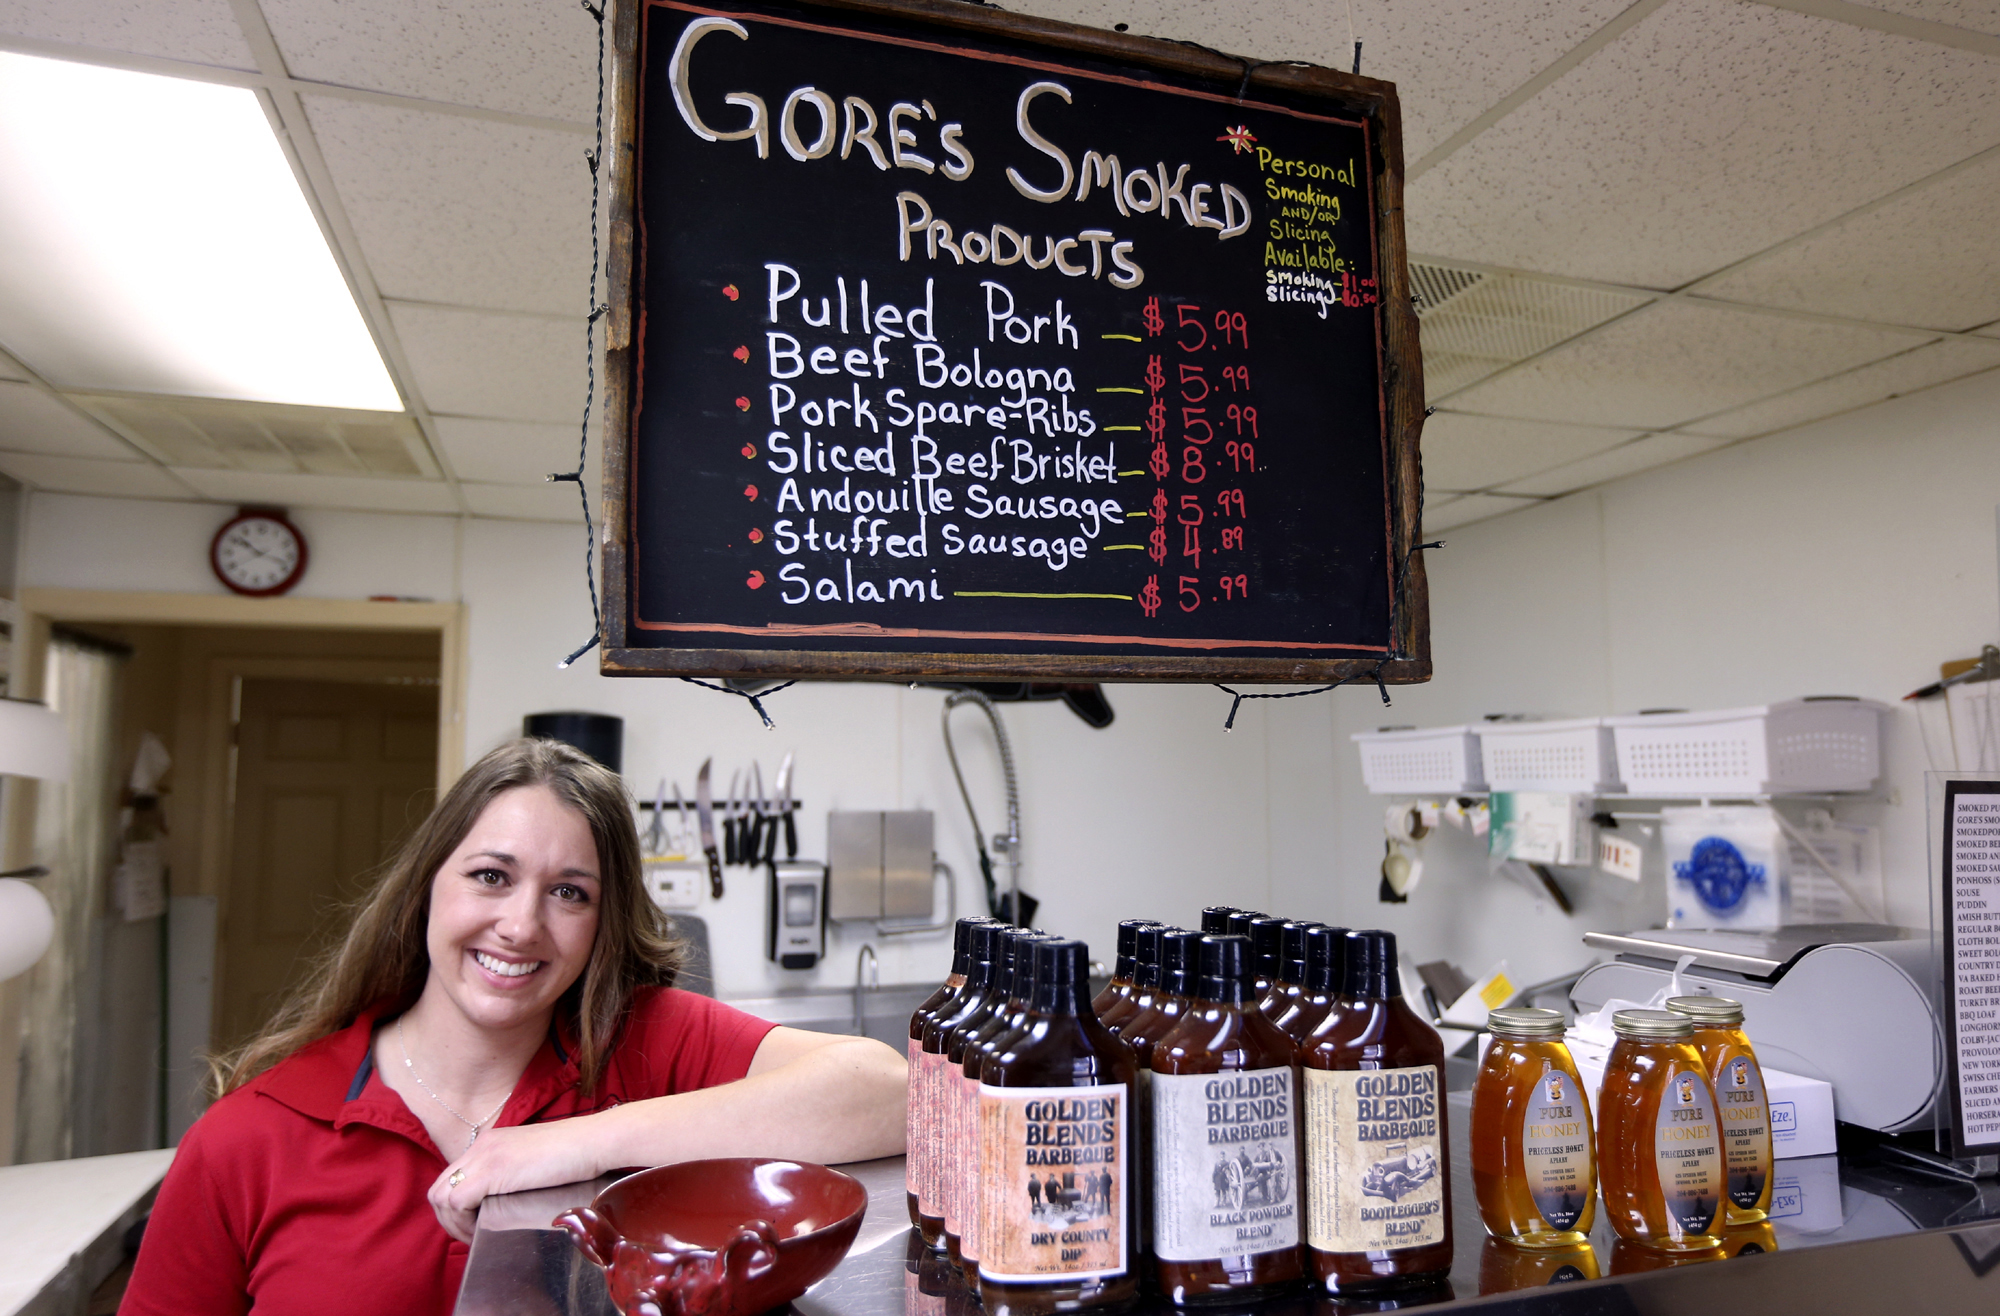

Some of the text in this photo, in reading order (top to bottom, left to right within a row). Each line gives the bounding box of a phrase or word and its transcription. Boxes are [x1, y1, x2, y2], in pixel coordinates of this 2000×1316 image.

[1006, 82, 1251, 240] SMOKED
[1256, 146, 1355, 188] Personal
[1265, 177, 1340, 221] Smoking
[1282, 206, 1336, 226] AND/OR
[896, 191, 1144, 289] PRODUCTS
[1269, 219, 1336, 253] Slicing
[765, 263, 938, 342] Pulled
[980, 281, 1078, 350] Pork
[766, 332, 891, 379] Beef
[913, 343, 1075, 408] Bologna
[769, 383, 879, 433] Pork
[886, 387, 1096, 437] Spare-Ribs
[768, 431, 896, 476] Sliced
[911, 435, 1007, 481] Beef
[1009, 439, 1118, 484] Brisket
[777, 477, 955, 516] Andouille
[965, 484, 1124, 538] Sausage
[775, 515, 928, 558] Stuffed
[942, 523, 1087, 571] Sausage
[779, 558, 944, 604] Salami
[1957, 804, 1990, 812] SMOKED
[1956, 840, 1988, 848] SMOKED
[1956, 852, 1988, 860] SMOKED
[1956, 864, 1988, 872] SMOKED
[1956, 889, 1980, 897] SOUSE
[1957, 901, 1986, 909] PUDDIN
[1957, 913, 1982, 921] AMISH
[1958, 925, 1992, 933] REGULAR
[1958, 938, 1983, 946] CLOTH
[1958, 950, 1982, 958] SWEET
[1958, 962, 1994, 970] COUNTRY
[1970, 974, 1995, 982] BAKED
[1959, 986, 1983, 995] ROAST
[1959, 998, 1988, 1007] TURKEY
[1960, 1010, 1996, 1021] BBQ LOAF
[1962, 1061, 1980, 1070] NEW
[1355, 1071, 1435, 1098] GOLDEN
[1963, 1073, 1985, 1082] SWISS
[1205, 1072, 1288, 1100] GOLDEN
[1964, 1085, 1998, 1095] FARMERS
[1725, 1090, 1755, 1103] PURE
[1965, 1098, 1991, 1108] SLICED
[1025, 1098, 1116, 1121] GOLDEN
[1206, 1096, 1288, 1124] BLENDS
[1356, 1094, 1435, 1121] BLENDS
[1539, 1106, 1572, 1120] PURE
[1670, 1108, 1703, 1122] PURE
[1025, 1121, 1115, 1146] BLENDS
[1208, 1120, 1289, 1144] BARBEQUE
[1358, 1119, 1436, 1141] BARBEQUE
[1529, 1122, 1582, 1138] HONEY
[1660, 1125, 1712, 1141] HONEY
[1724, 1127, 1764, 1137] ICELESS HONEY
[1968, 1124, 1984, 1133] HOT
[1026, 1146, 1115, 1166] BARBEQUE
[1528, 1144, 1584, 1156] PRICELESS HONEY
[1660, 1147, 1715, 1158] PRICELESS HONEY
[1210, 1204, 1293, 1227] BLACK POWDER
[1360, 1200, 1440, 1221] BOOTLEGGER'S
[1031, 1228, 1110, 1245] DRY COUNTY
